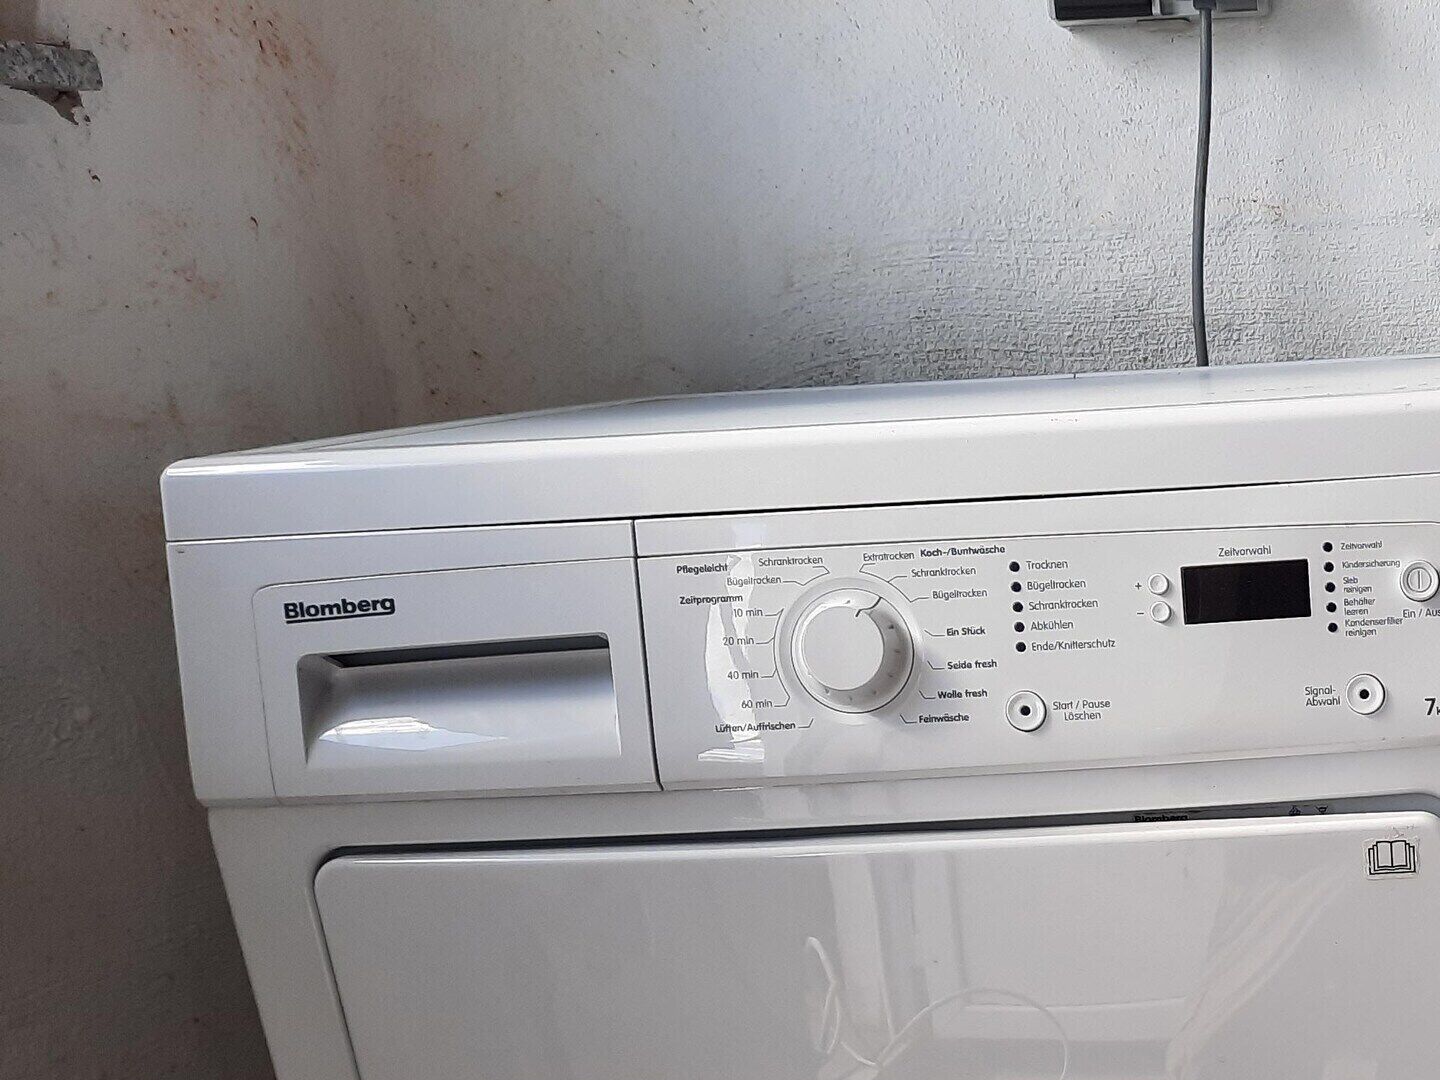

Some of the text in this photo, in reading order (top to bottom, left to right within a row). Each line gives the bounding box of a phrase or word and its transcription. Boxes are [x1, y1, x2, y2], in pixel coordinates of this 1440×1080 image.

[863, 551, 915, 562] Extratrocken
[1218, 545, 1272, 557] Zeitvorwahl
[758, 556, 824, 567] Schranktrocken
[1026, 560, 1069, 570] Trocknen
[676, 563, 728, 575] Pflegeleicht
[911, 567, 977, 578] Schranktrocken
[726, 575, 782, 588] Bügeltrocken
[1027, 579, 1086, 592] Bügeltrocken
[679, 593, 743, 606] Zeitprogramm
[932, 589, 988, 601] Bügeltrocken
[1028, 599, 1099, 611] Schranktrocken
[284, 598, 395, 624] Blomberg
[733, 608, 763, 618] 10 min
[1402, 609, 1416, 618] Ein
[946, 626, 986, 636] Ein Stück
[1030, 620, 1074, 631] Abkühlen
[722, 636, 755, 646] 20 min
[947, 659, 997, 670] Seide fresh
[727, 670, 759, 679] 40 min
[937, 689, 988, 699] Wolle fresh
[1305, 685, 1336, 697] Signal-
[741, 699, 773, 709] 60 min
[1053, 700, 1073, 710] Start
[1082, 700, 1111, 709] Pause
[1305, 696, 1341, 707] Abwahl
[919, 713, 970, 723] Feinwäsche
[1064, 710, 1102, 721] Löschen
